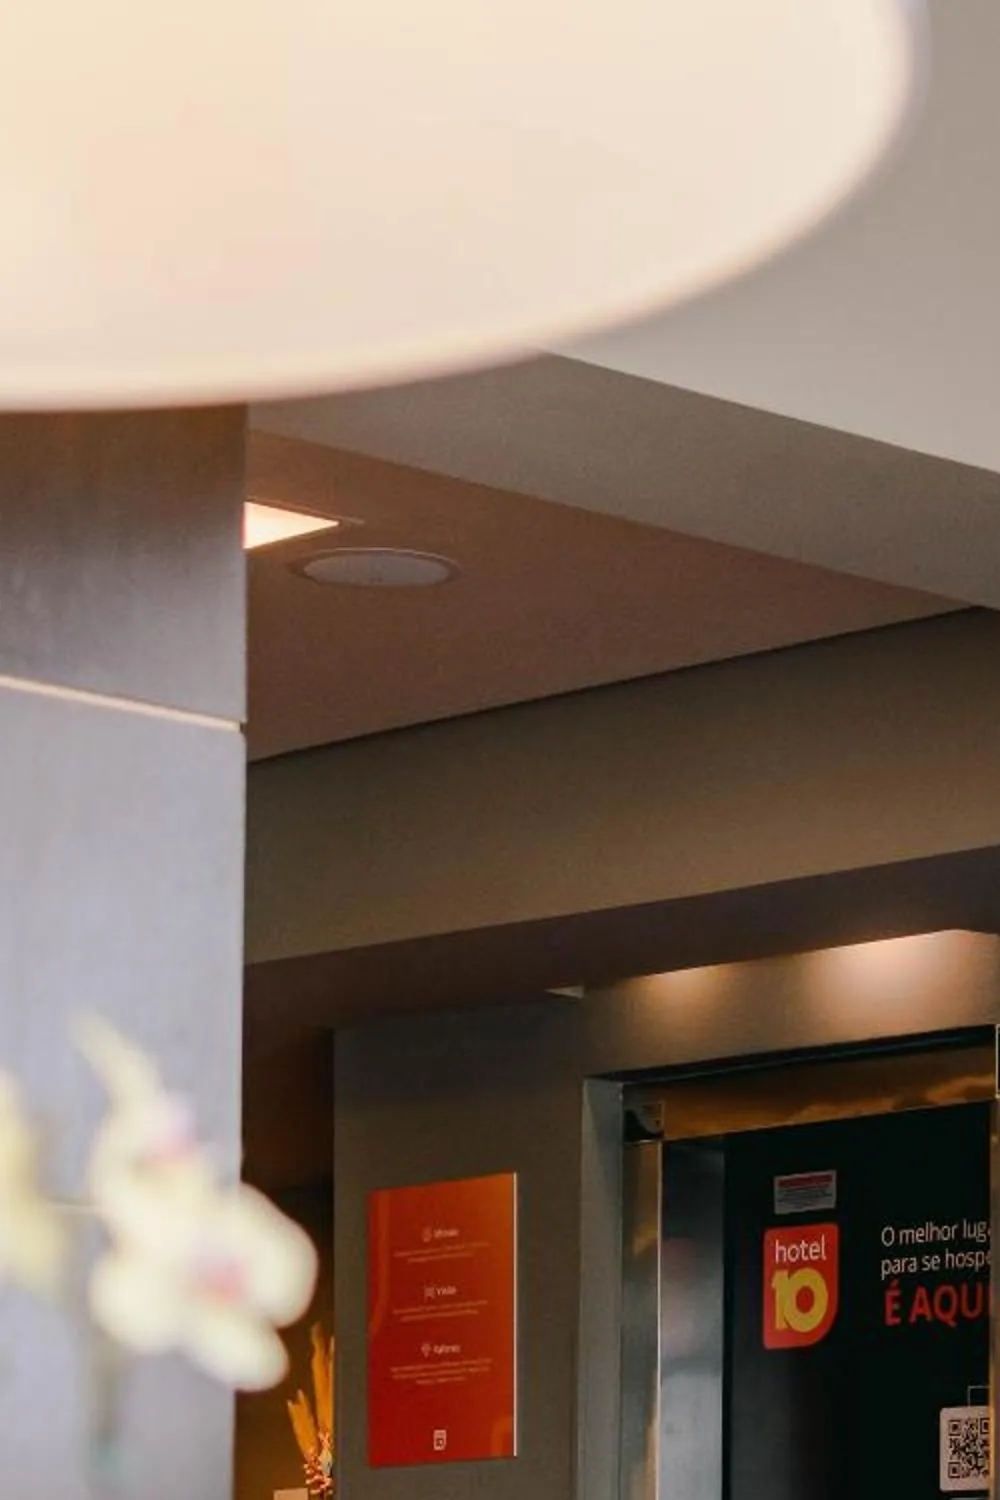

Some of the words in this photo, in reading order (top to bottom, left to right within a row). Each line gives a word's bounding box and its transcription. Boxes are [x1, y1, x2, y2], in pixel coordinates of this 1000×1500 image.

[881, 1226, 895, 1247] O
[899, 1221, 958, 1246] melhor
[962, 1218, 991, 1243] lug
[774, 1234, 827, 1264] hotel
[880, 1255, 918, 1281] para
[921, 1253, 942, 1271] se
[770, 1267, 829, 1333] 10
[884, 1279, 903, 1326] É
